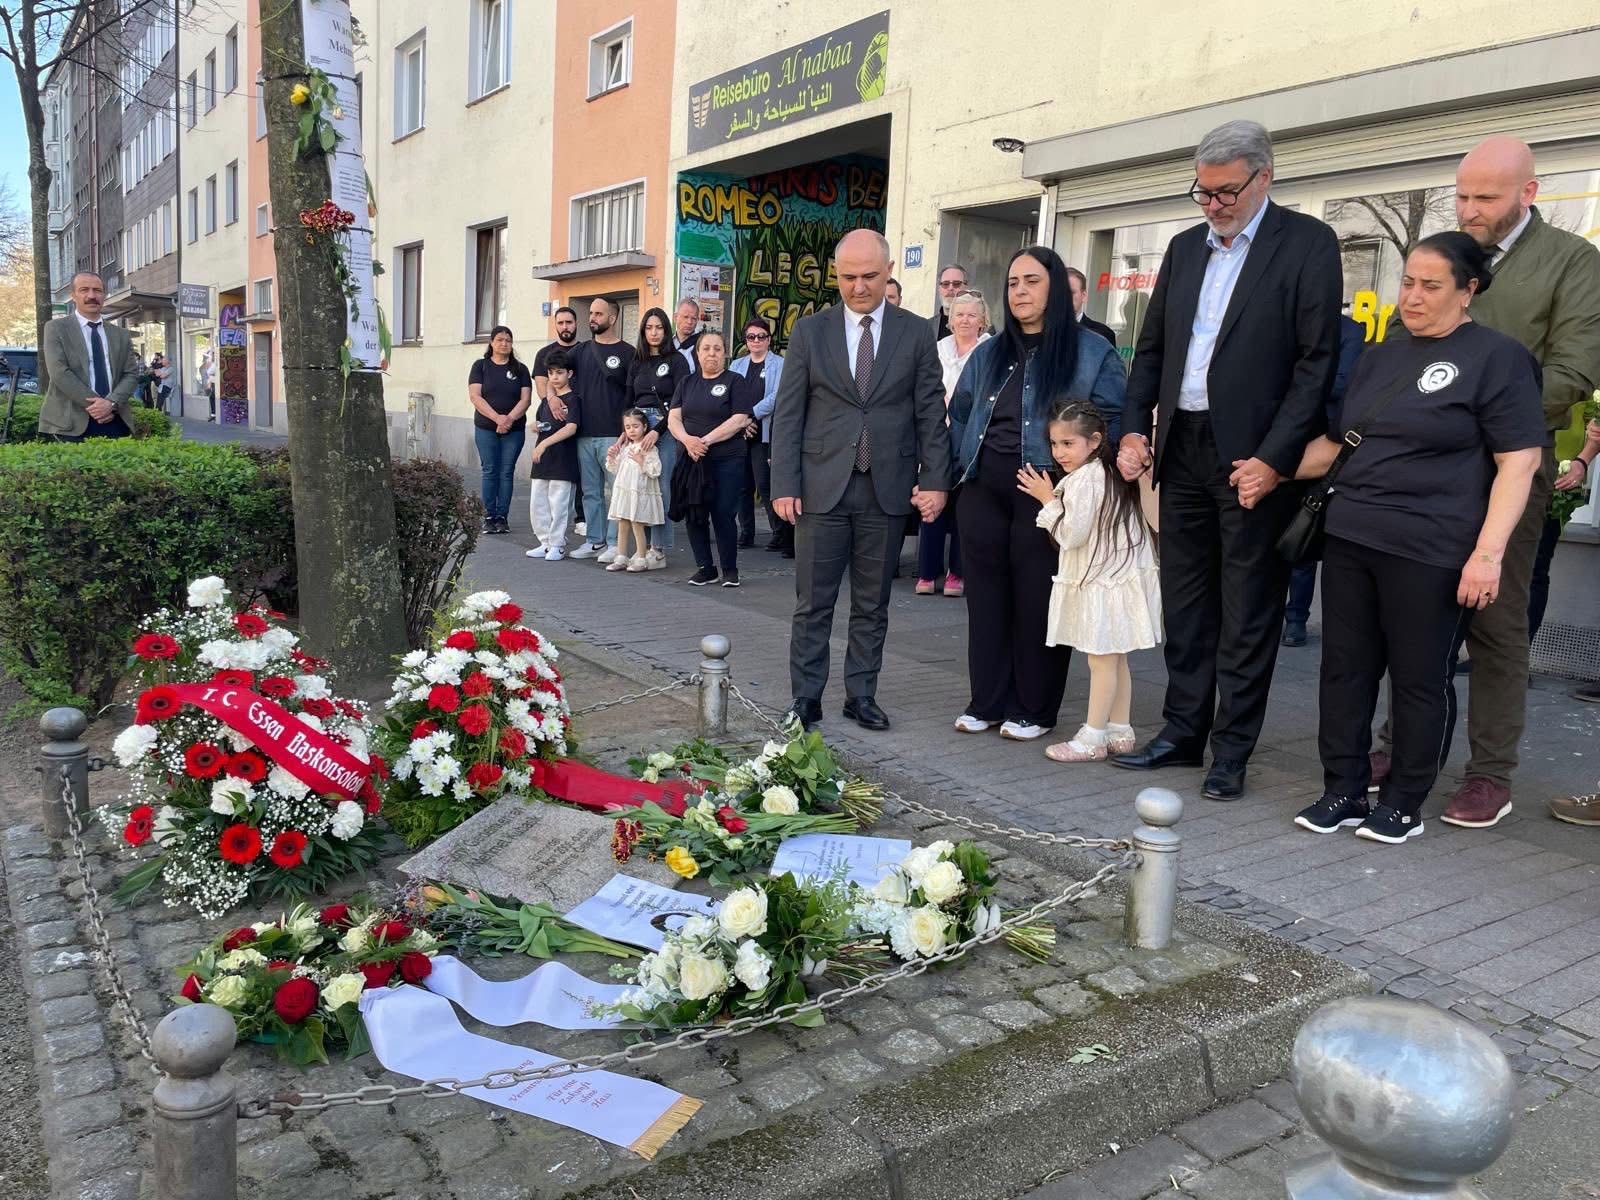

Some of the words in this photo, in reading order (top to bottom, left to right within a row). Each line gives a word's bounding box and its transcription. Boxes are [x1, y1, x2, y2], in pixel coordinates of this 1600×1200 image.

[712, 69, 771, 110] Reisebüro
[777, 48, 802, 88] Al
[801, 37, 853, 75] nabaa
[678, 181, 783, 226] ROMEO
[906, 249, 921, 264] 190
[222, 691, 238, 710] C.
[248, 701, 285, 740] Essen
